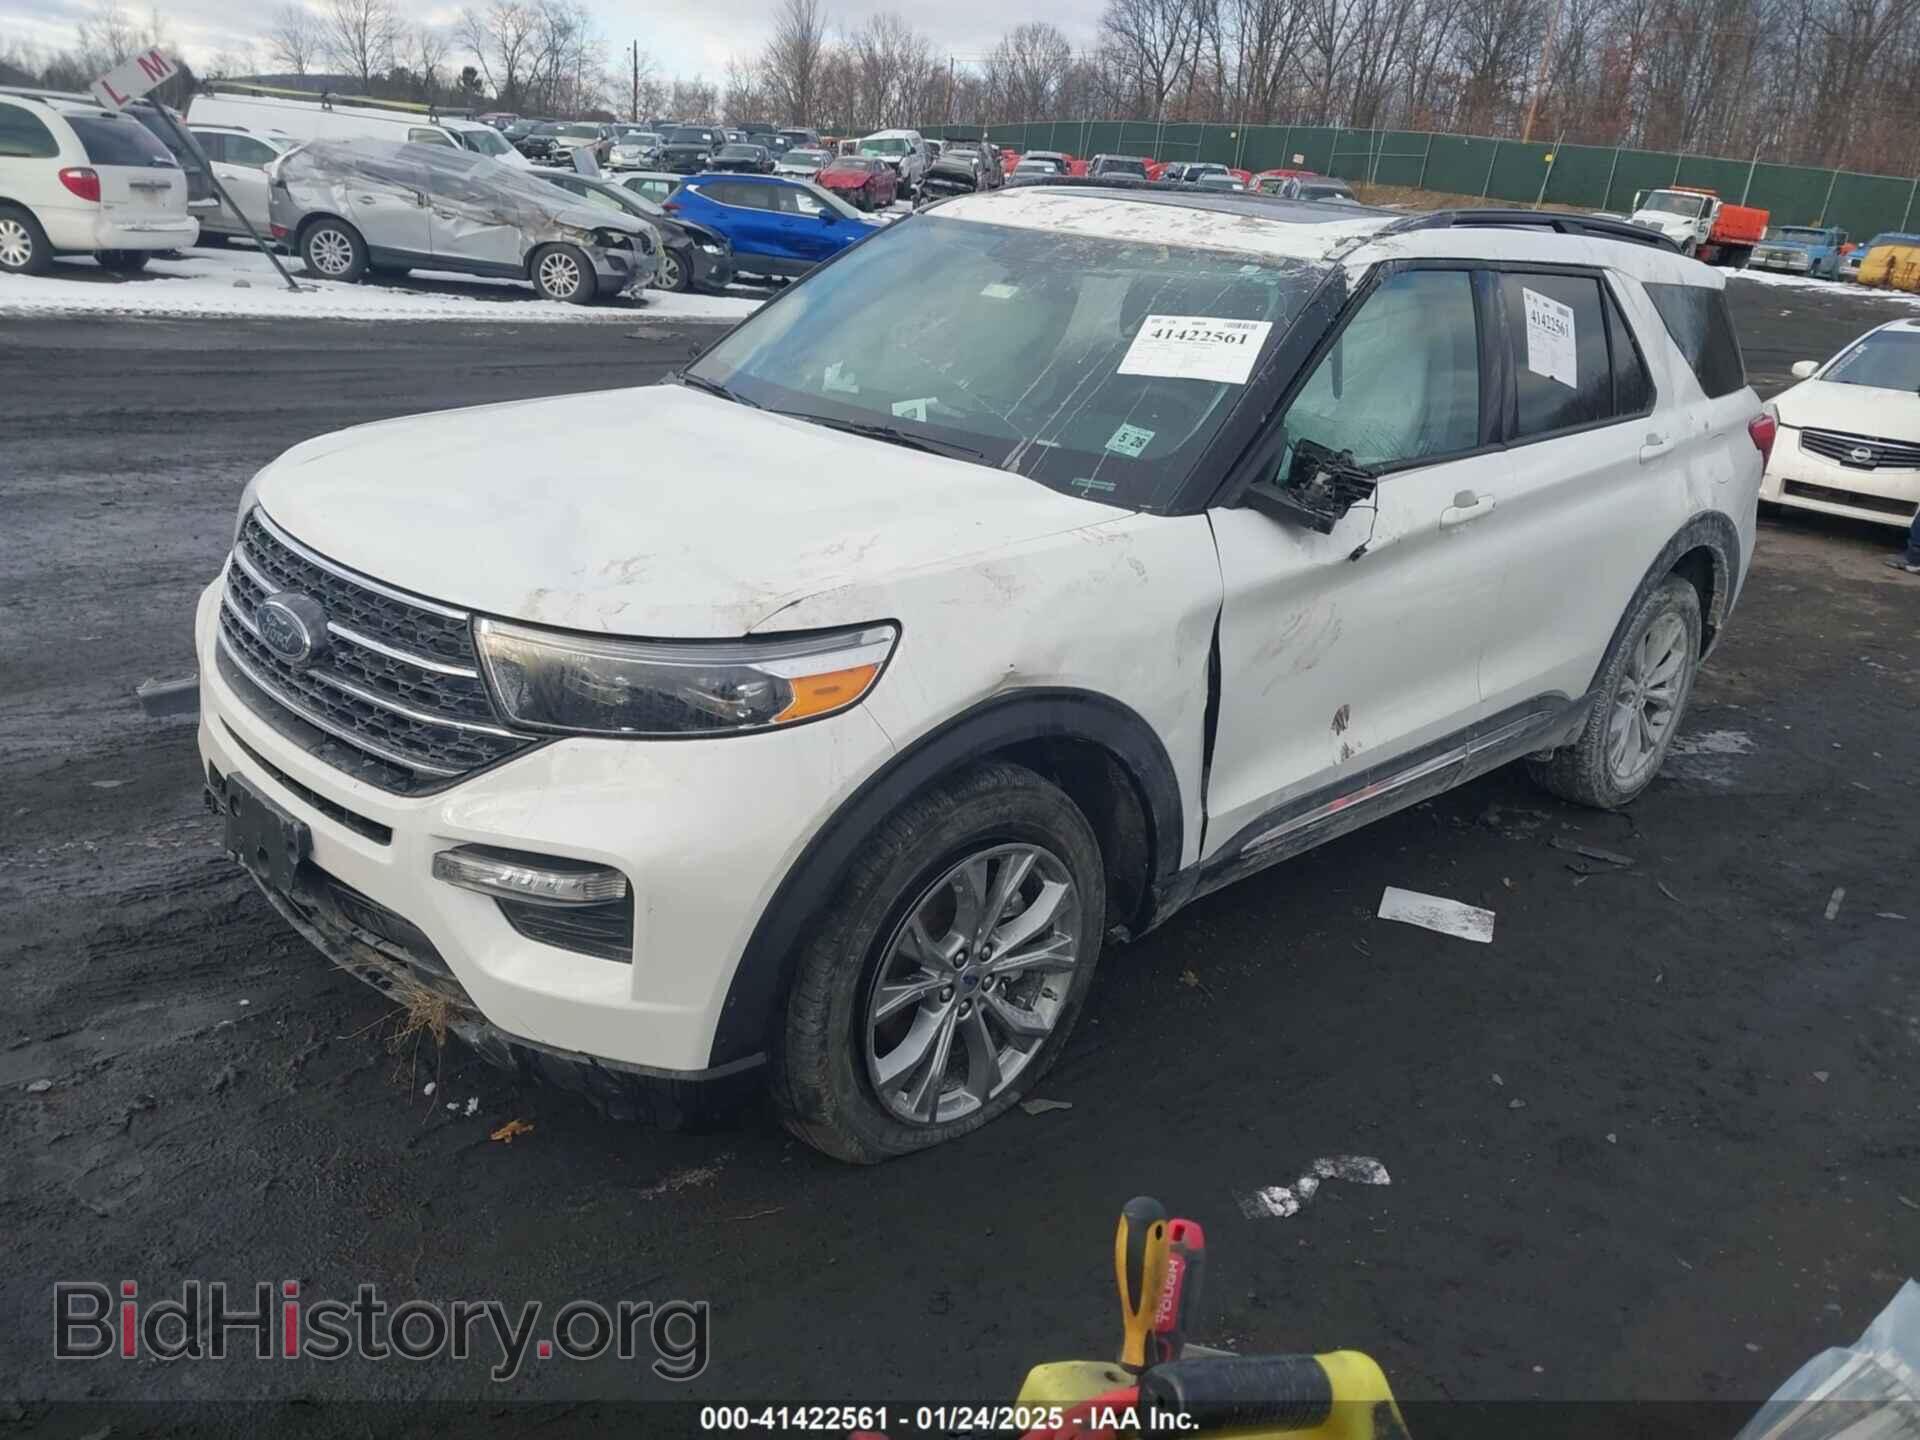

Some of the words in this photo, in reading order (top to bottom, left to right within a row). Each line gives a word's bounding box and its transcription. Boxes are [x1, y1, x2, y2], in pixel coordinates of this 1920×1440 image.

[101, 80, 130, 107] L
[137, 50, 172, 83] M
[1151, 328, 1248, 345] 41422561
[261, 610, 297, 652] Ford
[1158, 1259, 1179, 1322] TOUGH
